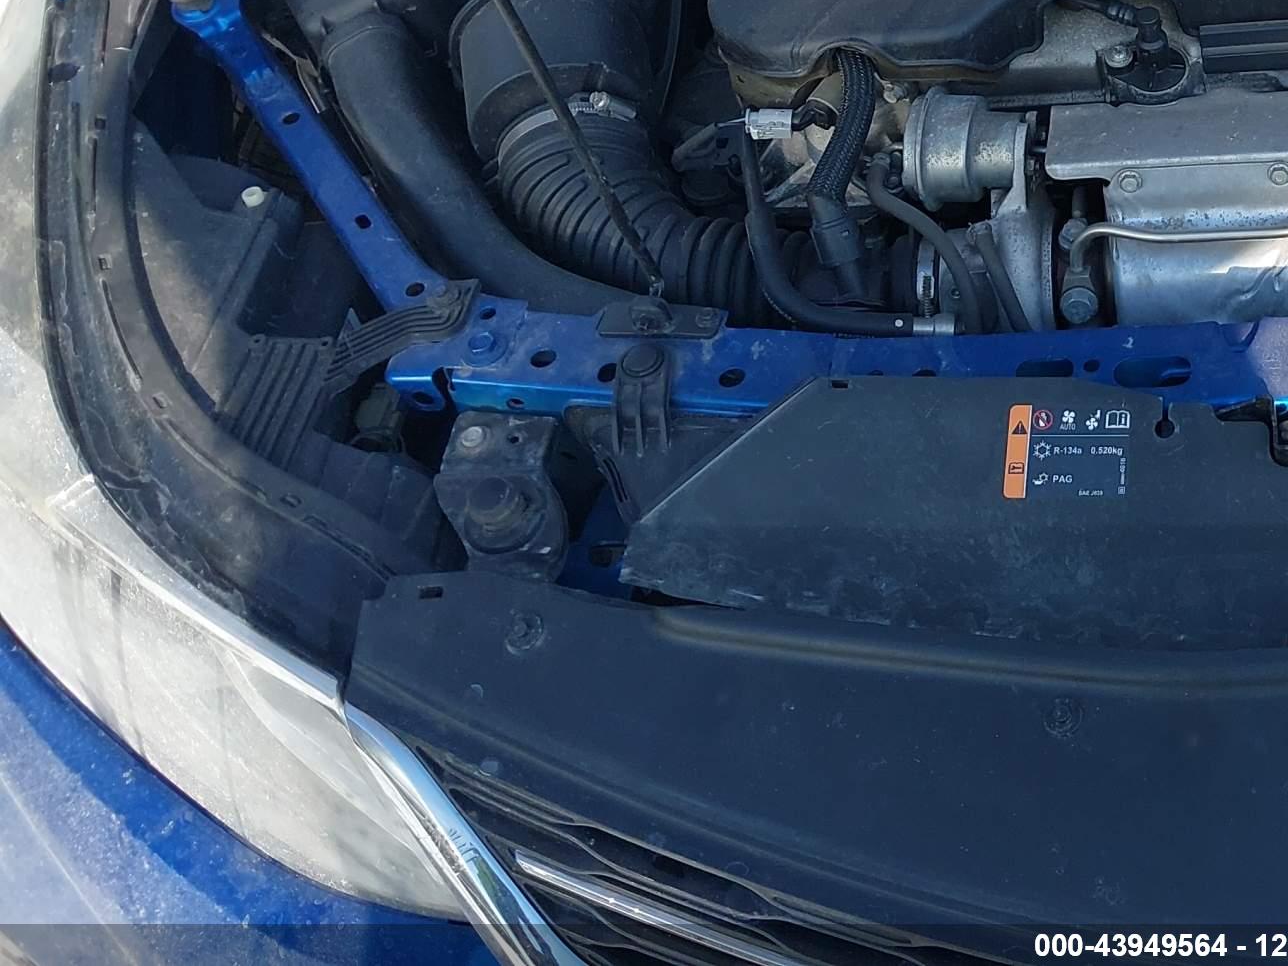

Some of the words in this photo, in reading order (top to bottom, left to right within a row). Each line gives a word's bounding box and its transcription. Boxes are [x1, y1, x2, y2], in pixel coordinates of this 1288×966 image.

[1060, 423, 1076, 431] AUTO
[1053, 446, 1083, 455] R-134a
[1090, 446, 1123, 456] 0.520kg
[1052, 474, 1073, 483] PAG
